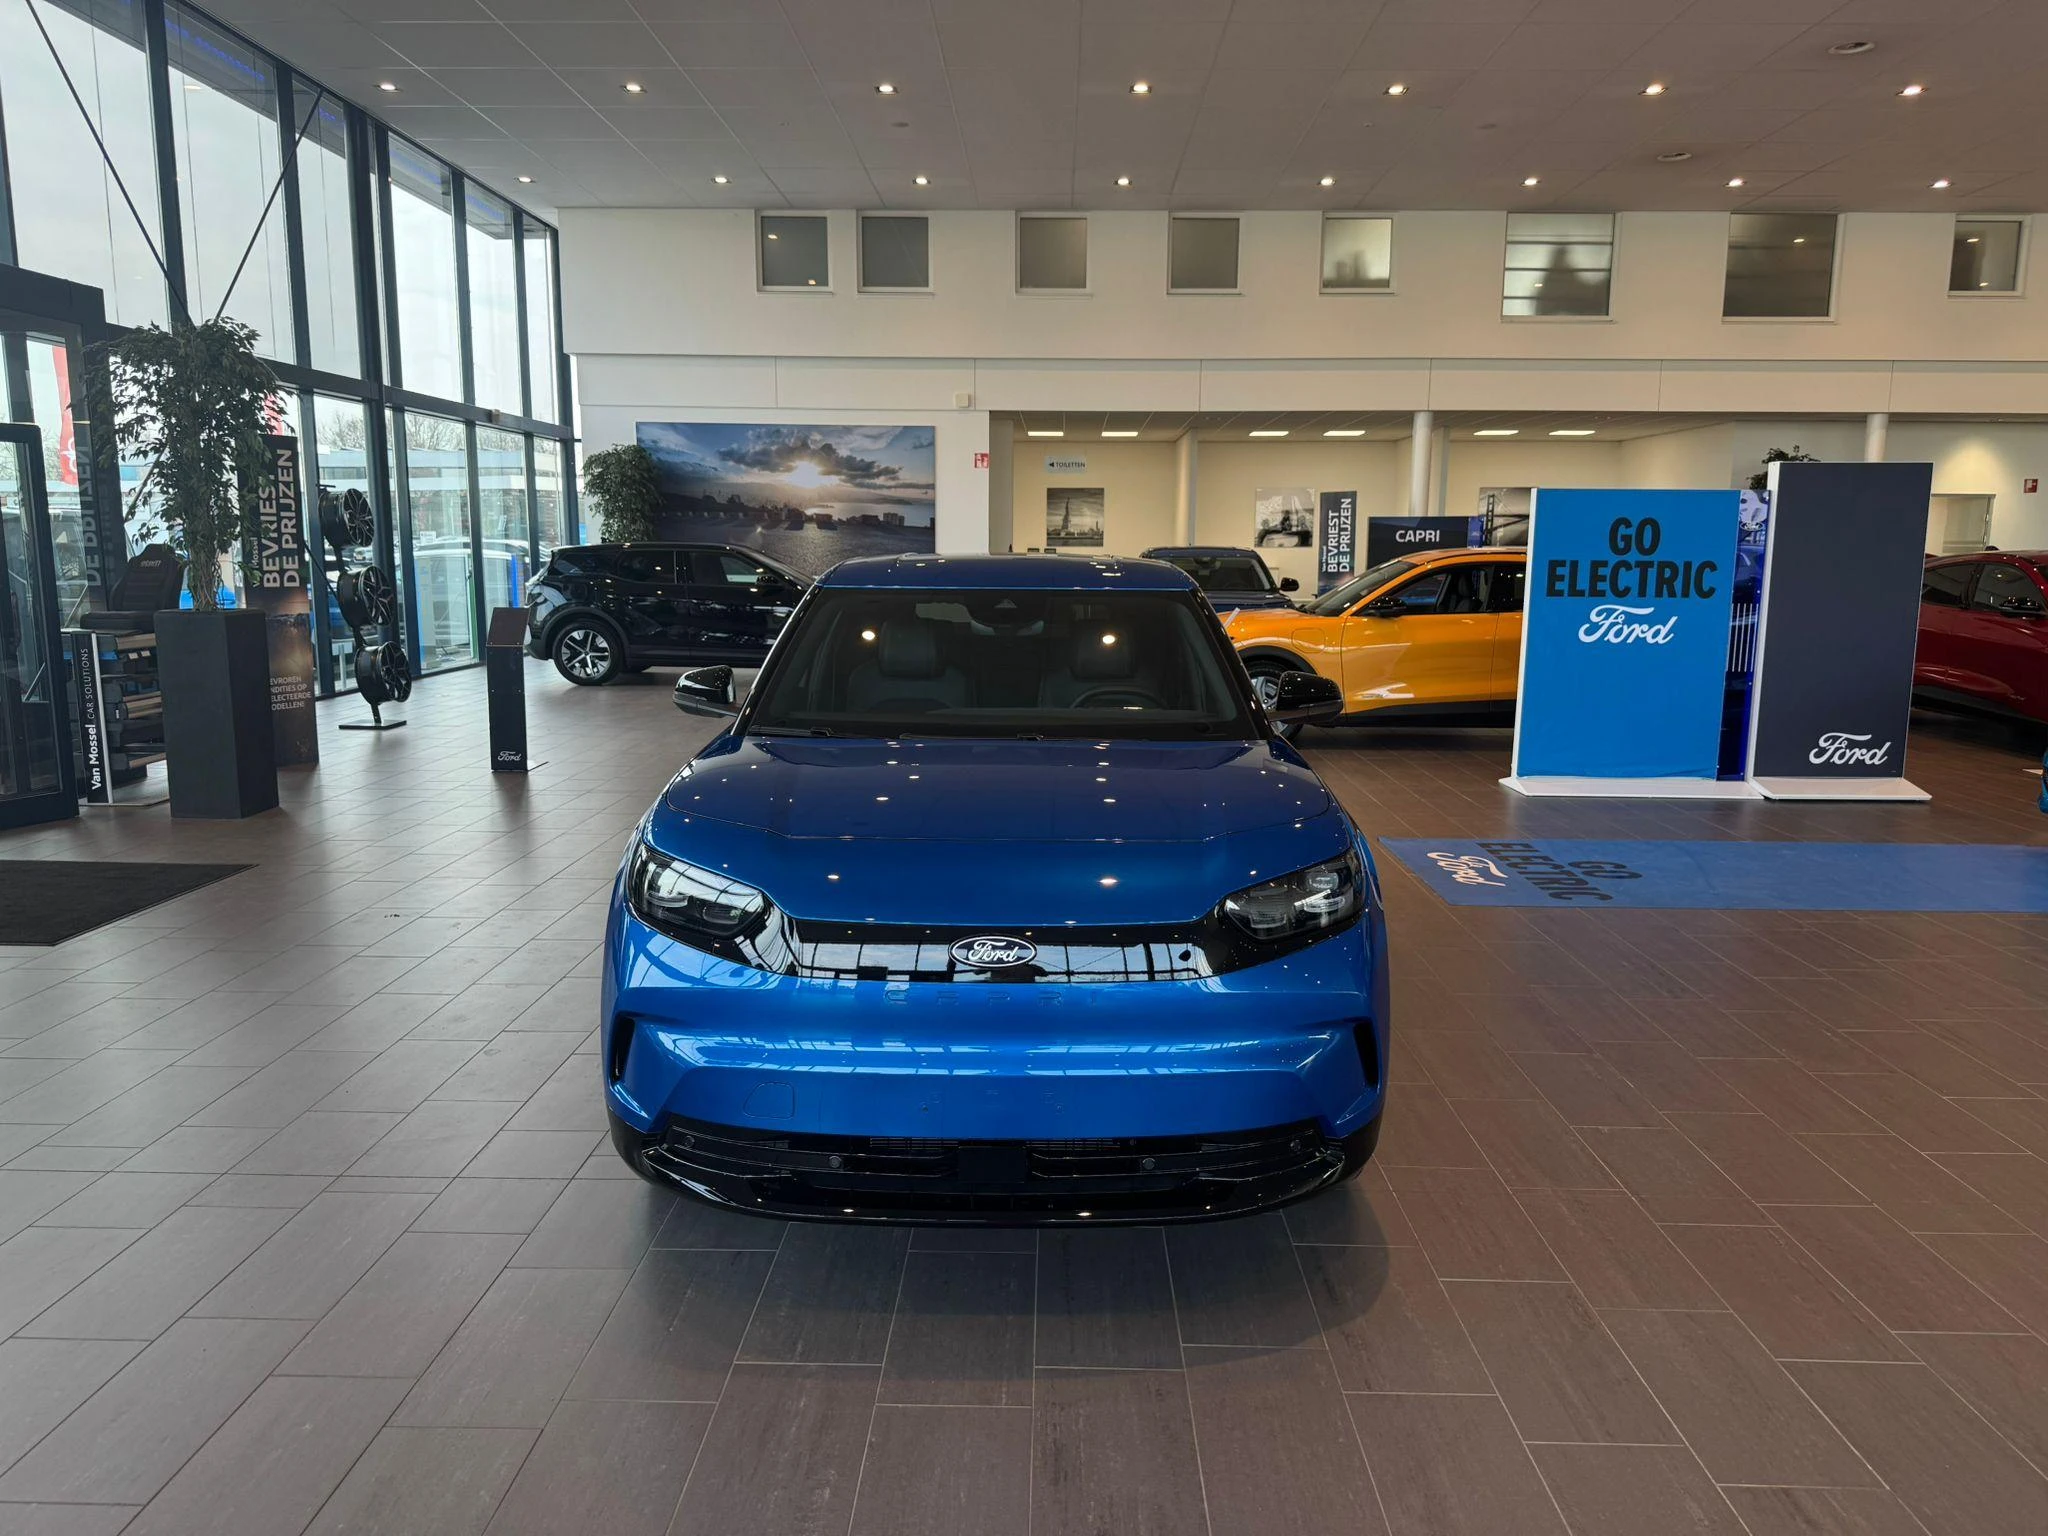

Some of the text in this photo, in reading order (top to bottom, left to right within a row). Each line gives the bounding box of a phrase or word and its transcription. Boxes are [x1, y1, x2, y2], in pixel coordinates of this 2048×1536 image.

[258, 474, 281, 589] BEVRIES
[277, 449, 300, 588] DE PRIJZEN
[1339, 498, 1352, 573] DE PRIJZEN
[1395, 529, 1440, 543] CAPRI
[1608, 516, 1661, 557] GO
[1327, 510, 1339, 573] BEVRIEST
[1546, 559, 1718, 599] ELECTRIC
[1578, 604, 1678, 644] Ford
[270, 675, 302, 685] EVROREN
[271, 691, 311, 702] ELECTEERDE
[297, 683, 307, 691] OP
[80, 648, 102, 790] Van Mossel CAR SOLUTIONS
[272, 700, 305, 710] ODELLEN!
[497, 750, 522, 761] Ford
[1808, 732, 1891, 765] Ford
[1426, 851, 1509, 887] Ford
[1475, 842, 1614, 901] ELECTRIC
[1568, 860, 1643, 879] GO
[967, 939, 1020, 963] Ford
